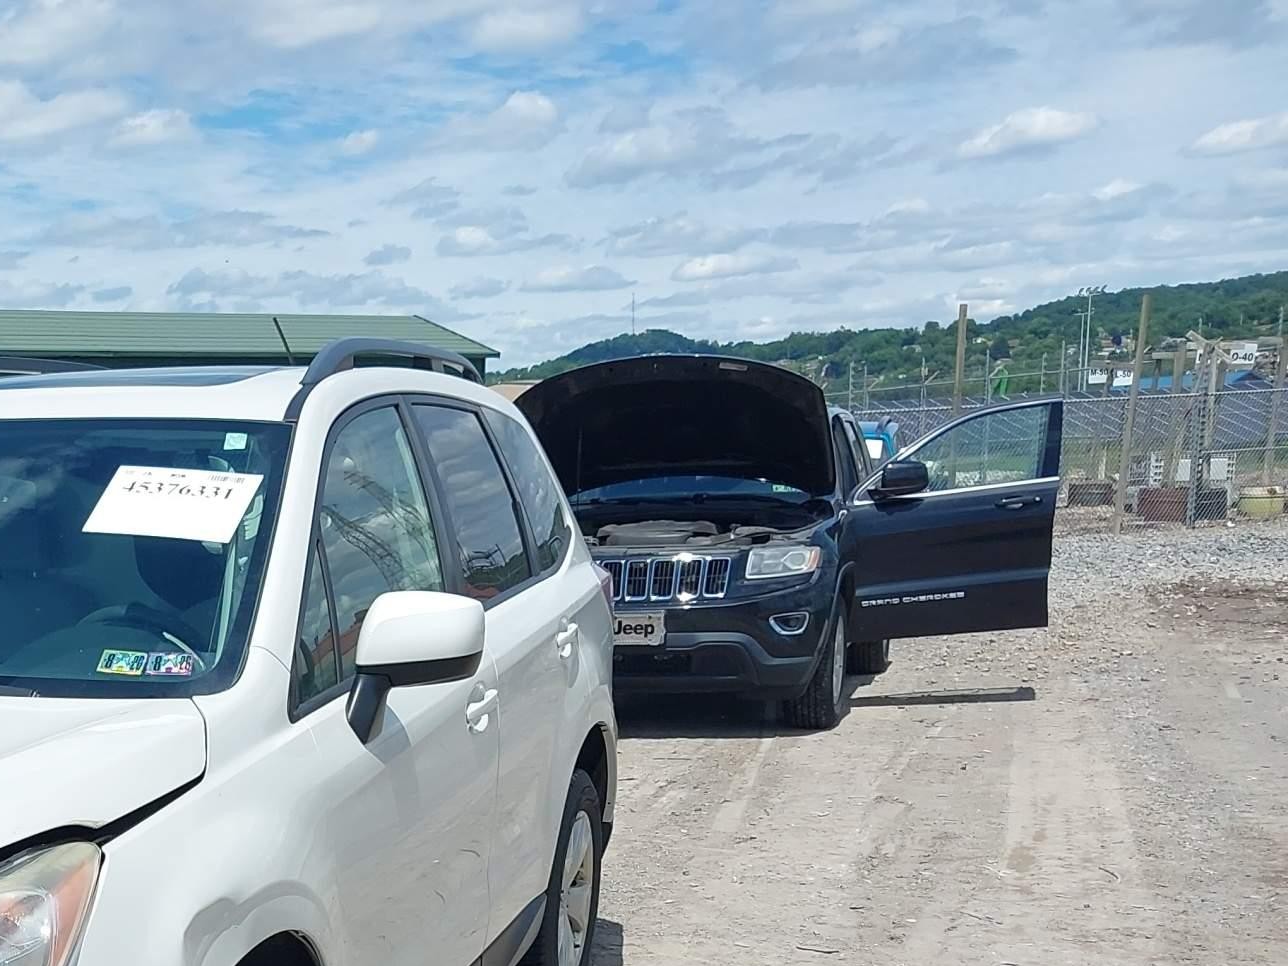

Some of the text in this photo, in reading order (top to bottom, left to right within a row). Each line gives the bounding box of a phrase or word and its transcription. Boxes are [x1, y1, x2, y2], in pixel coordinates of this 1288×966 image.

[122, 481, 233, 500] 45376331
[861, 591, 965, 608] GRAND CHEROKEE
[613, 619, 655, 638] Jeep
[104, 653, 116, 669] 8
[153, 655, 162, 672] 8
